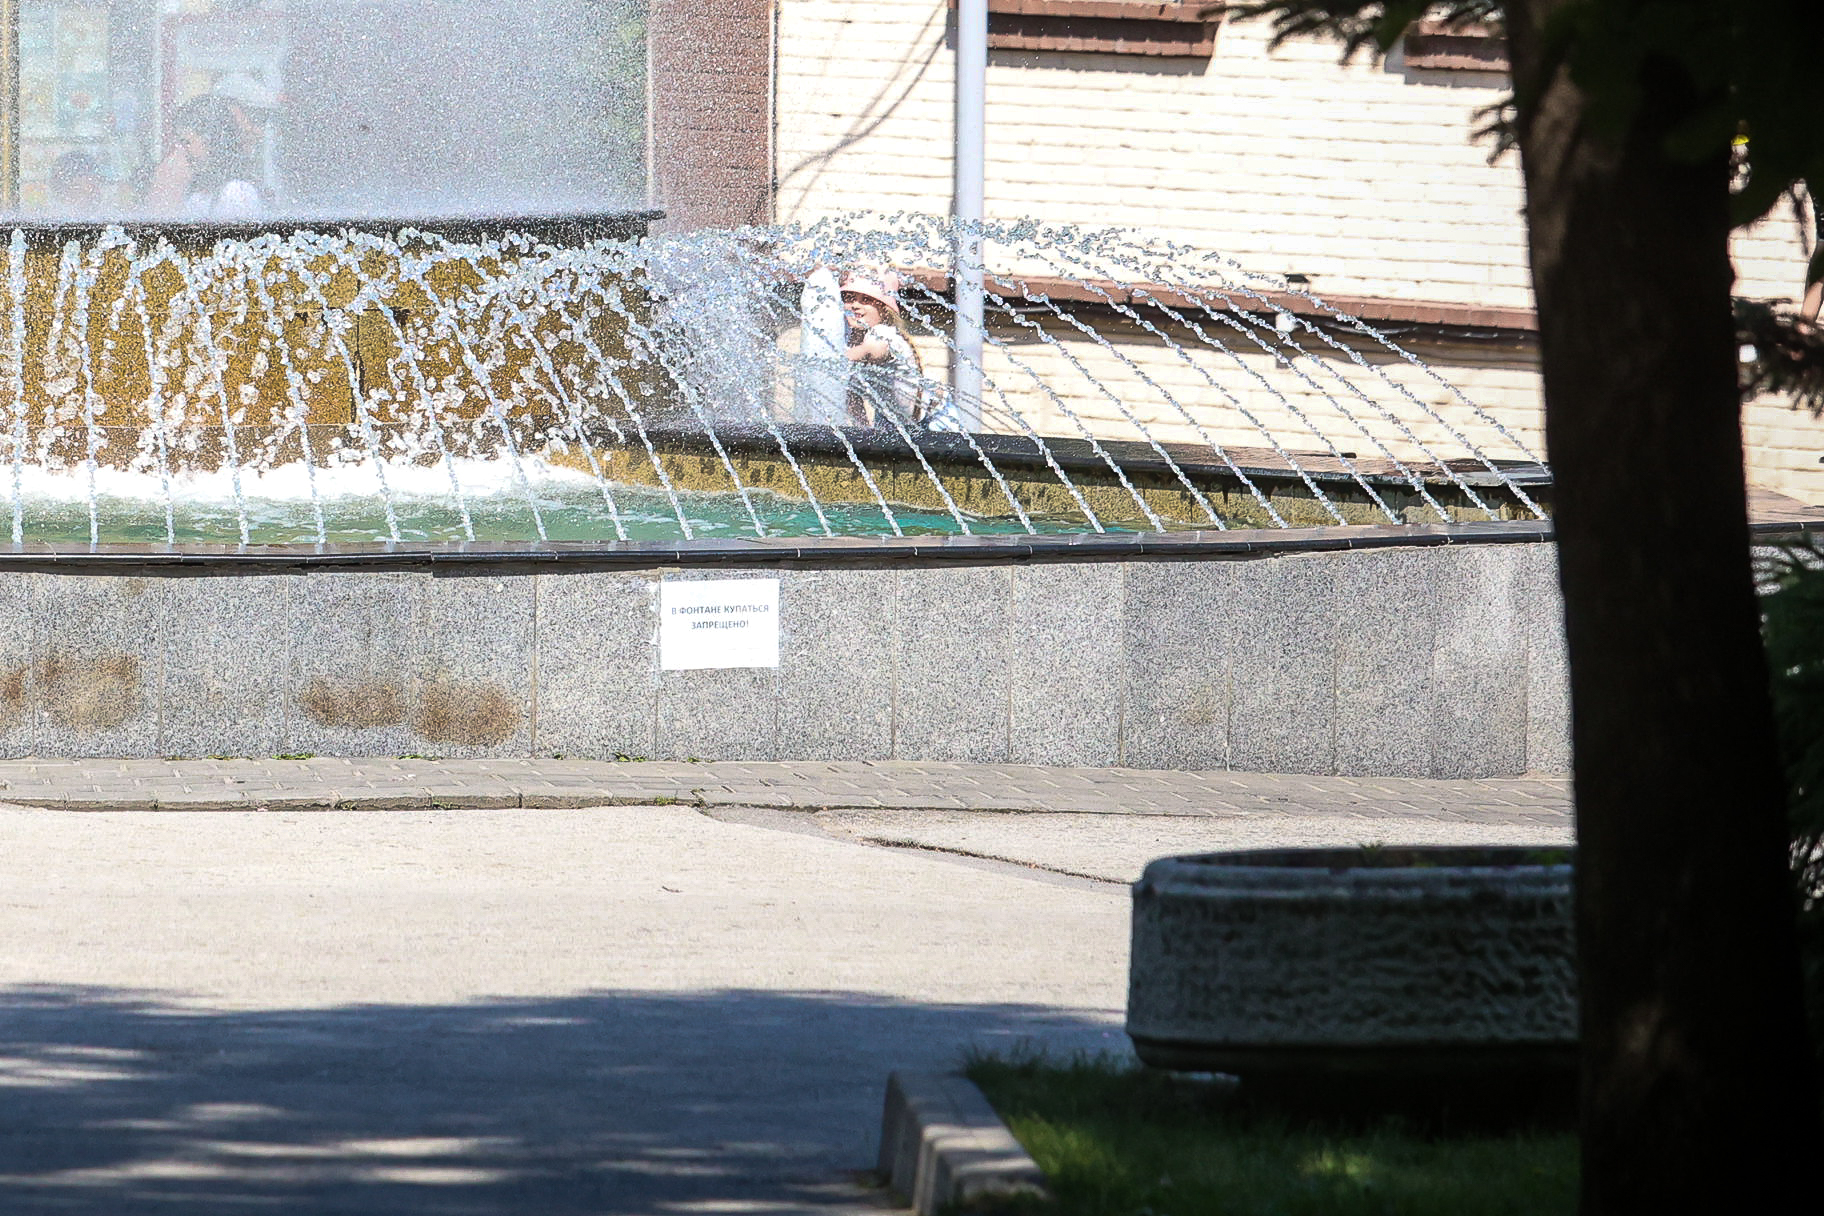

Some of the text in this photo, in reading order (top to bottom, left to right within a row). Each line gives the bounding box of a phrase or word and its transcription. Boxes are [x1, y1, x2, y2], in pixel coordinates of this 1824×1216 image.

[680, 605, 721, 614] ФОНТАНЕ
[724, 604, 769, 614] КУПАТЬСЯ
[691, 620, 749, 629] ЗАПРЕЩЕНО!
